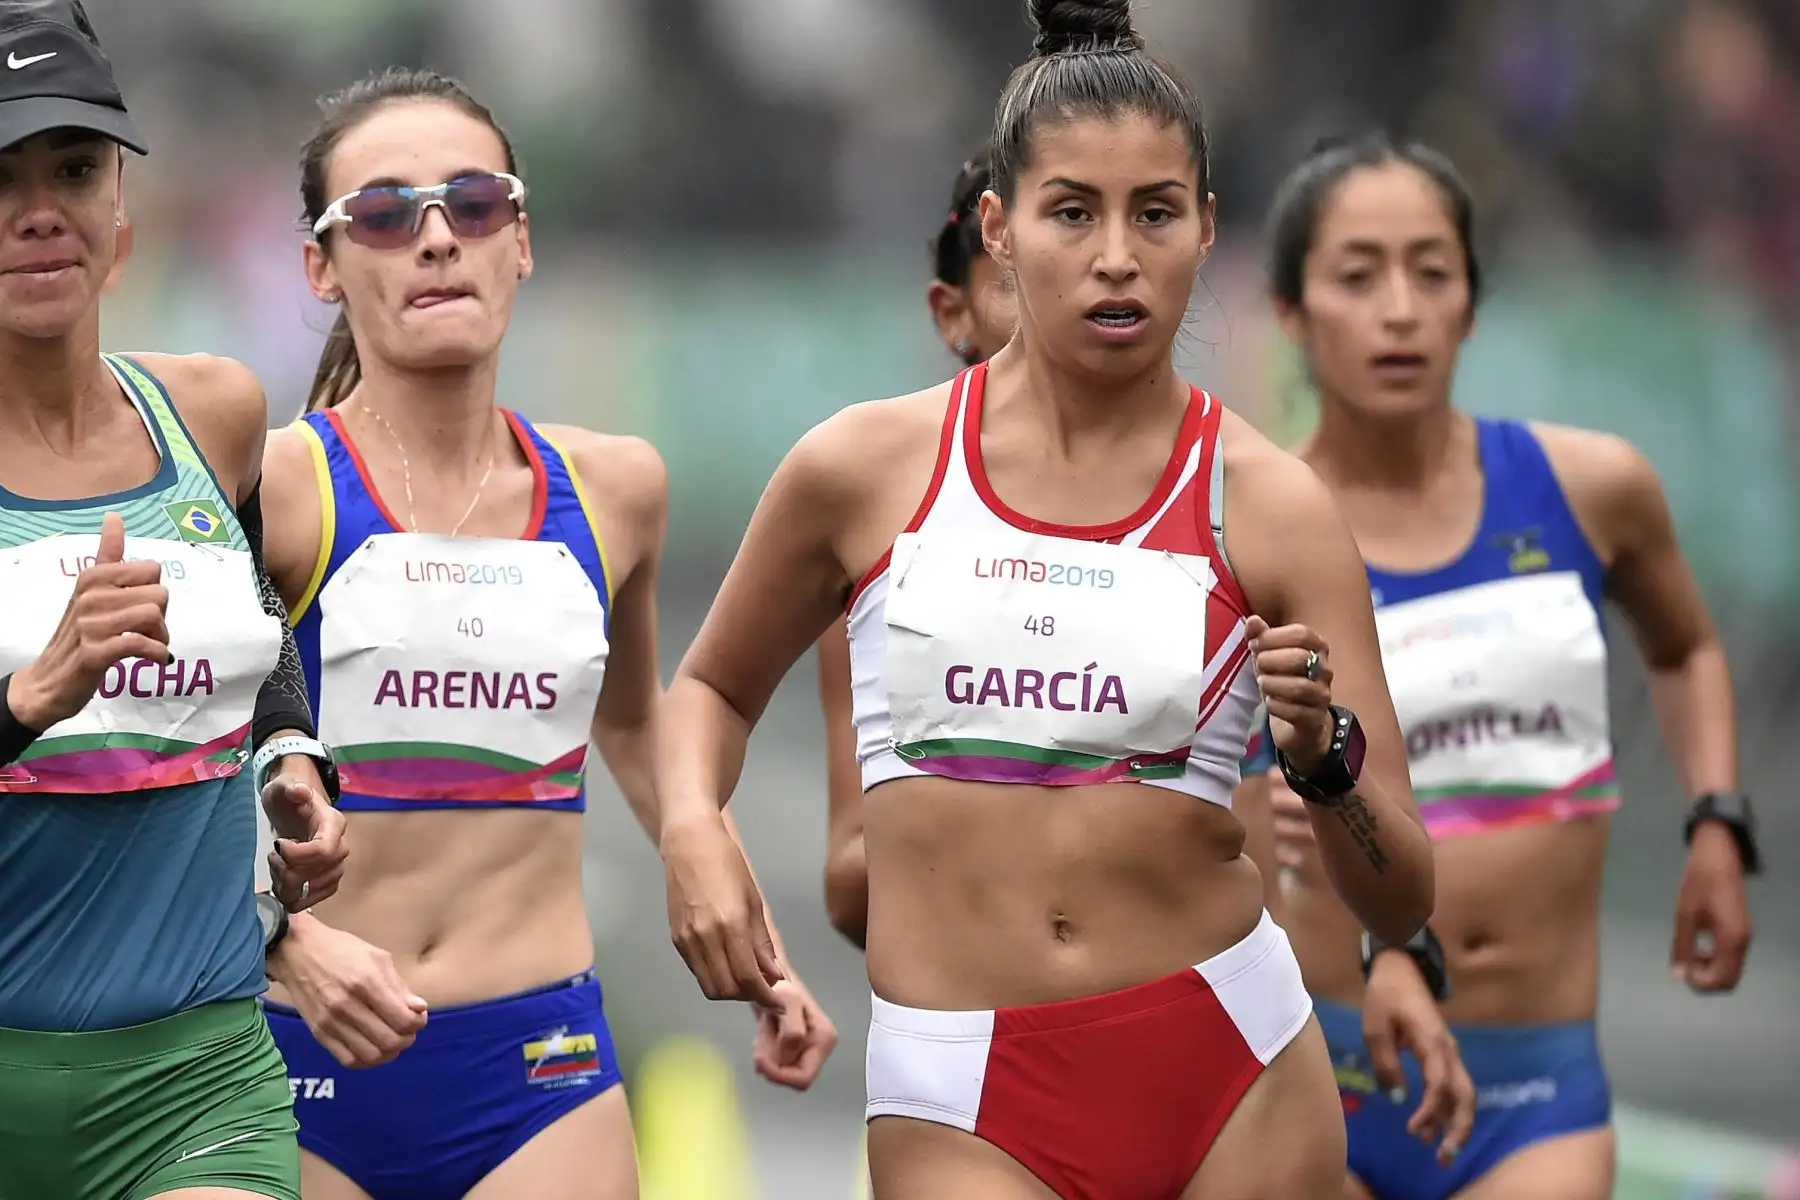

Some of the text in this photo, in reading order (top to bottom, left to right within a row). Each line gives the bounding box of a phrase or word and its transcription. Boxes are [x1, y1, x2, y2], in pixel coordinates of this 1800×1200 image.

[457, 617, 484, 638] 40
[1024, 615, 1056, 636] 48
[100, 658, 214, 699] OCHA
[373, 669, 559, 710] ARENAS
[944, 661, 1129, 715] GARCÍA
[289, 1077, 335, 1099] ETA
